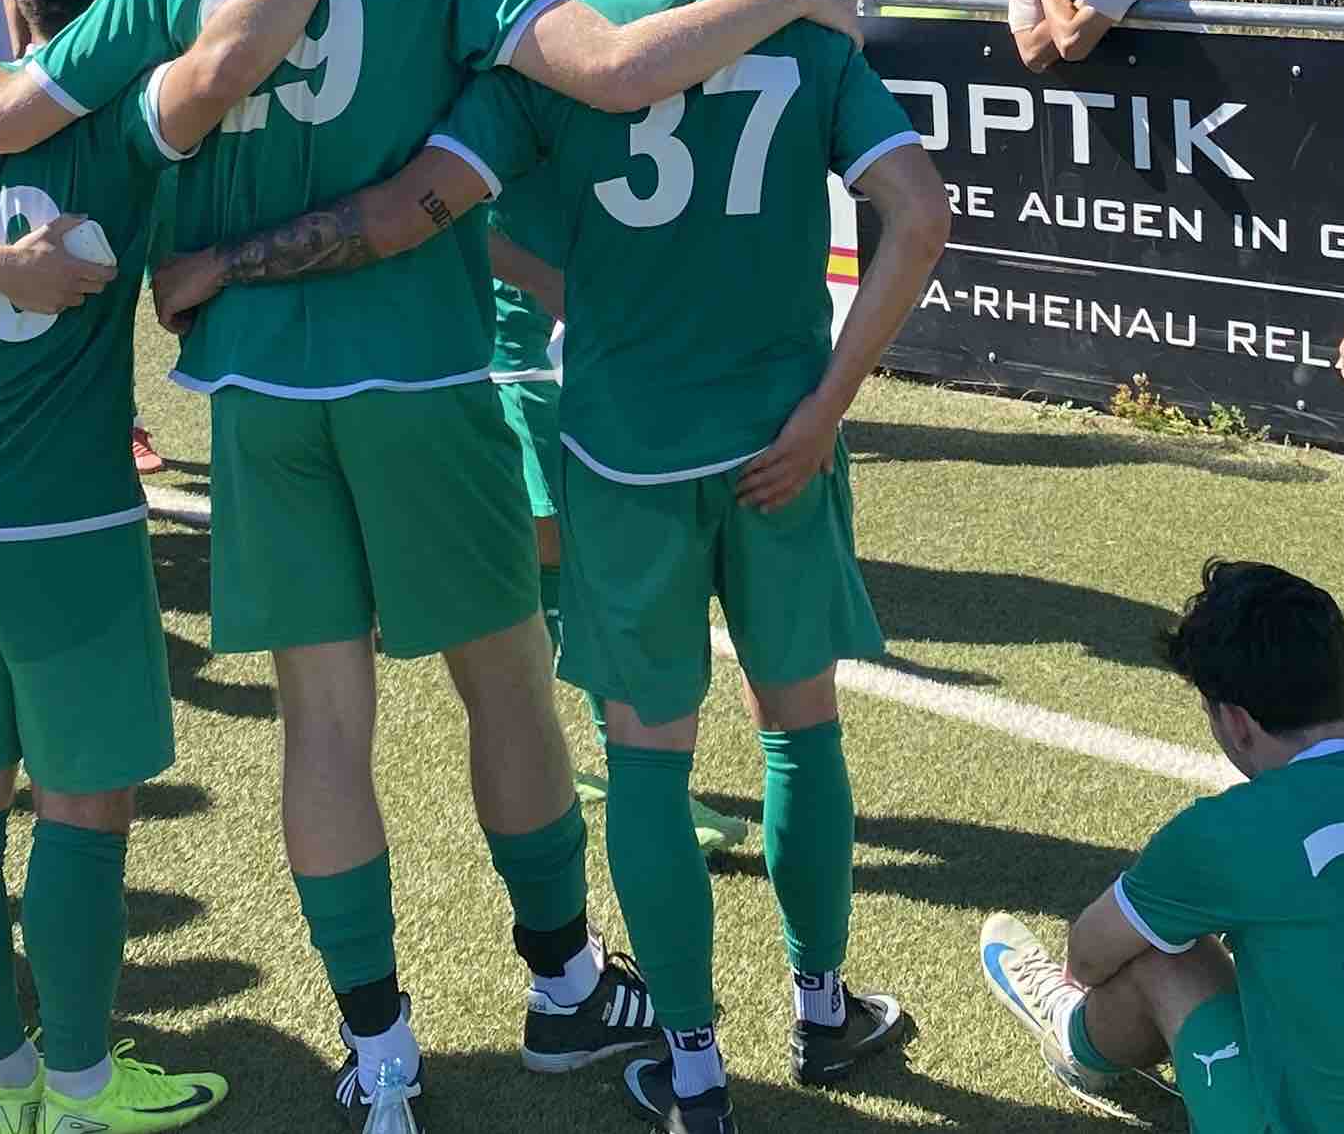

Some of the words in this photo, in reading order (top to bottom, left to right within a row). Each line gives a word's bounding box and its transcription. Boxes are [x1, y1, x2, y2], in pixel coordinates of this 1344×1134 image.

[594, 53, 800, 227] 37
[882, 78, 1254, 181] OPTIK
[947, 183, 994, 219] RE
[1018, 192, 1203, 243] AUGEN
[1234, 213, 1288, 253] IN
[920, 278, 1196, 348] A-RHEINAU
